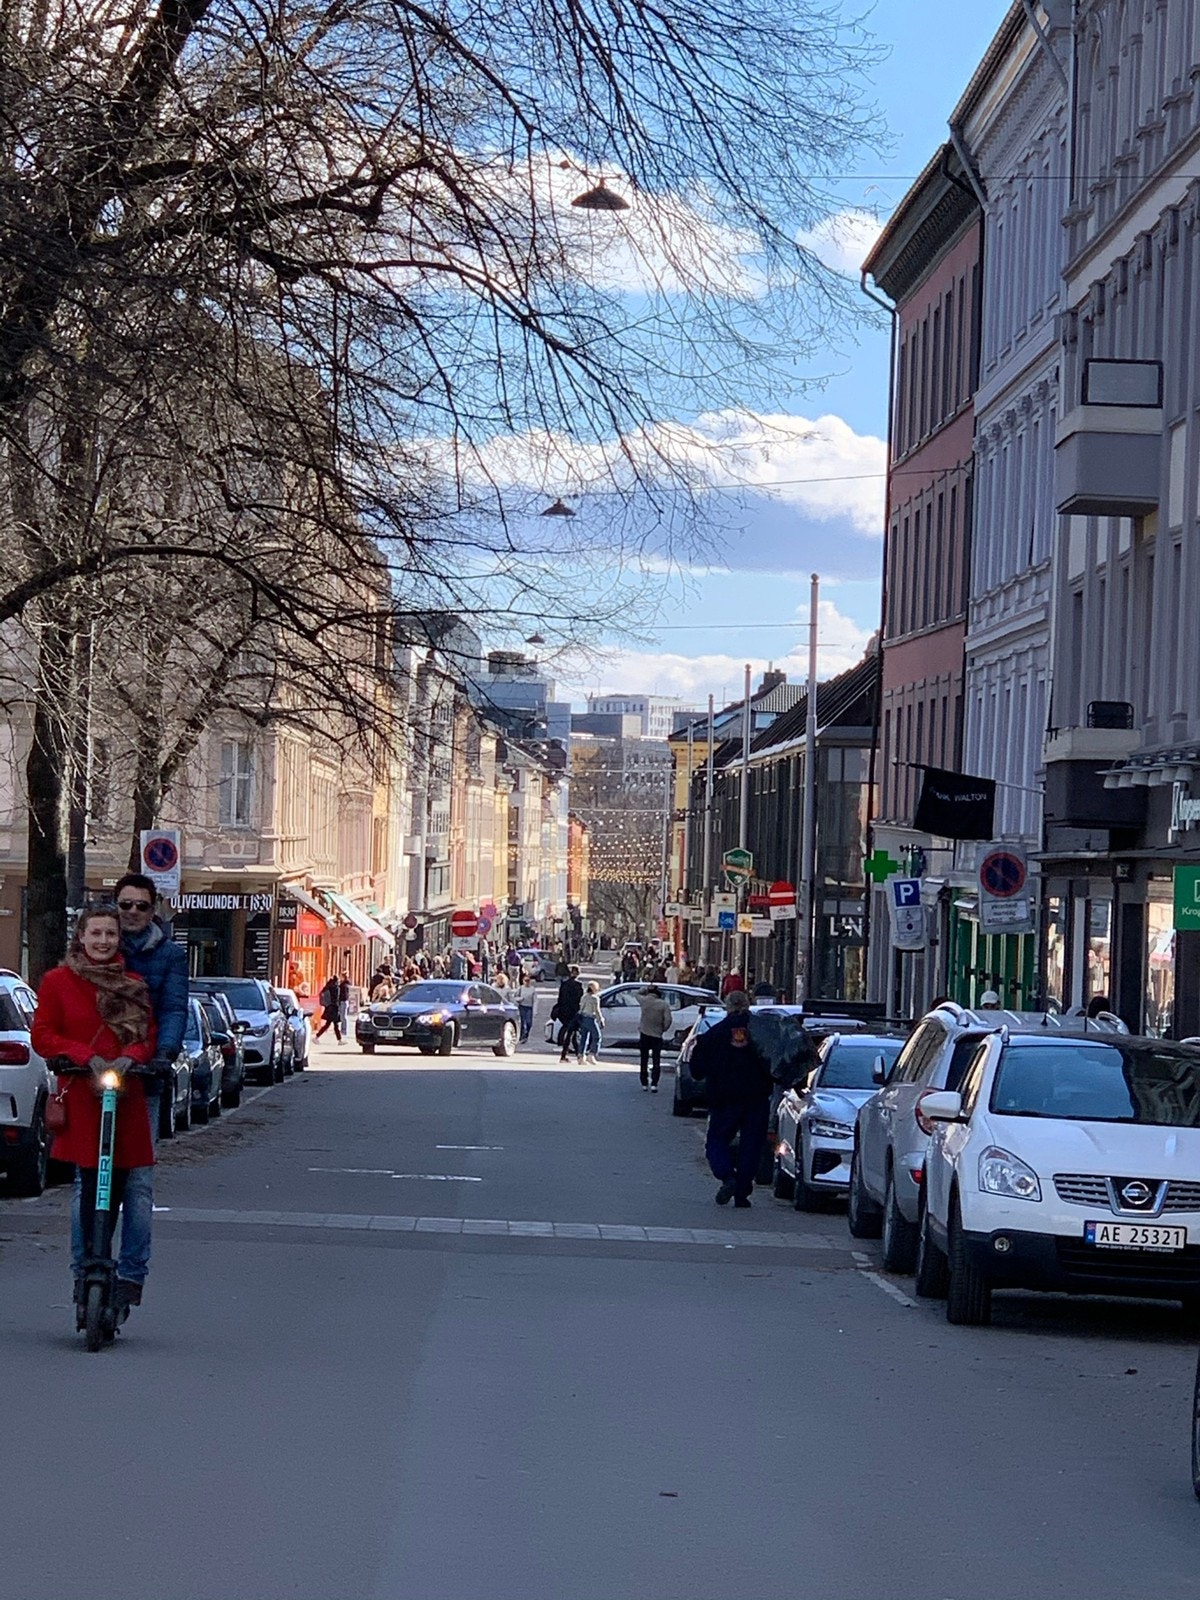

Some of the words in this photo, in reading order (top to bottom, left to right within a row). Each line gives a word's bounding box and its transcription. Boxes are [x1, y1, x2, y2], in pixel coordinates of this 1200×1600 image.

[954, 793, 987, 802] WALTON
[170, 894, 240, 909] OLIVENLUNDEN
[249, 893, 272, 911] 1830
[900, 884, 914, 904] P
[278, 906, 296, 918] 1830
[98, 1158, 110, 1206] TIER
[1100, 1226, 1121, 1243] AE
[1129, 1227, 1180, 1246] 25321
